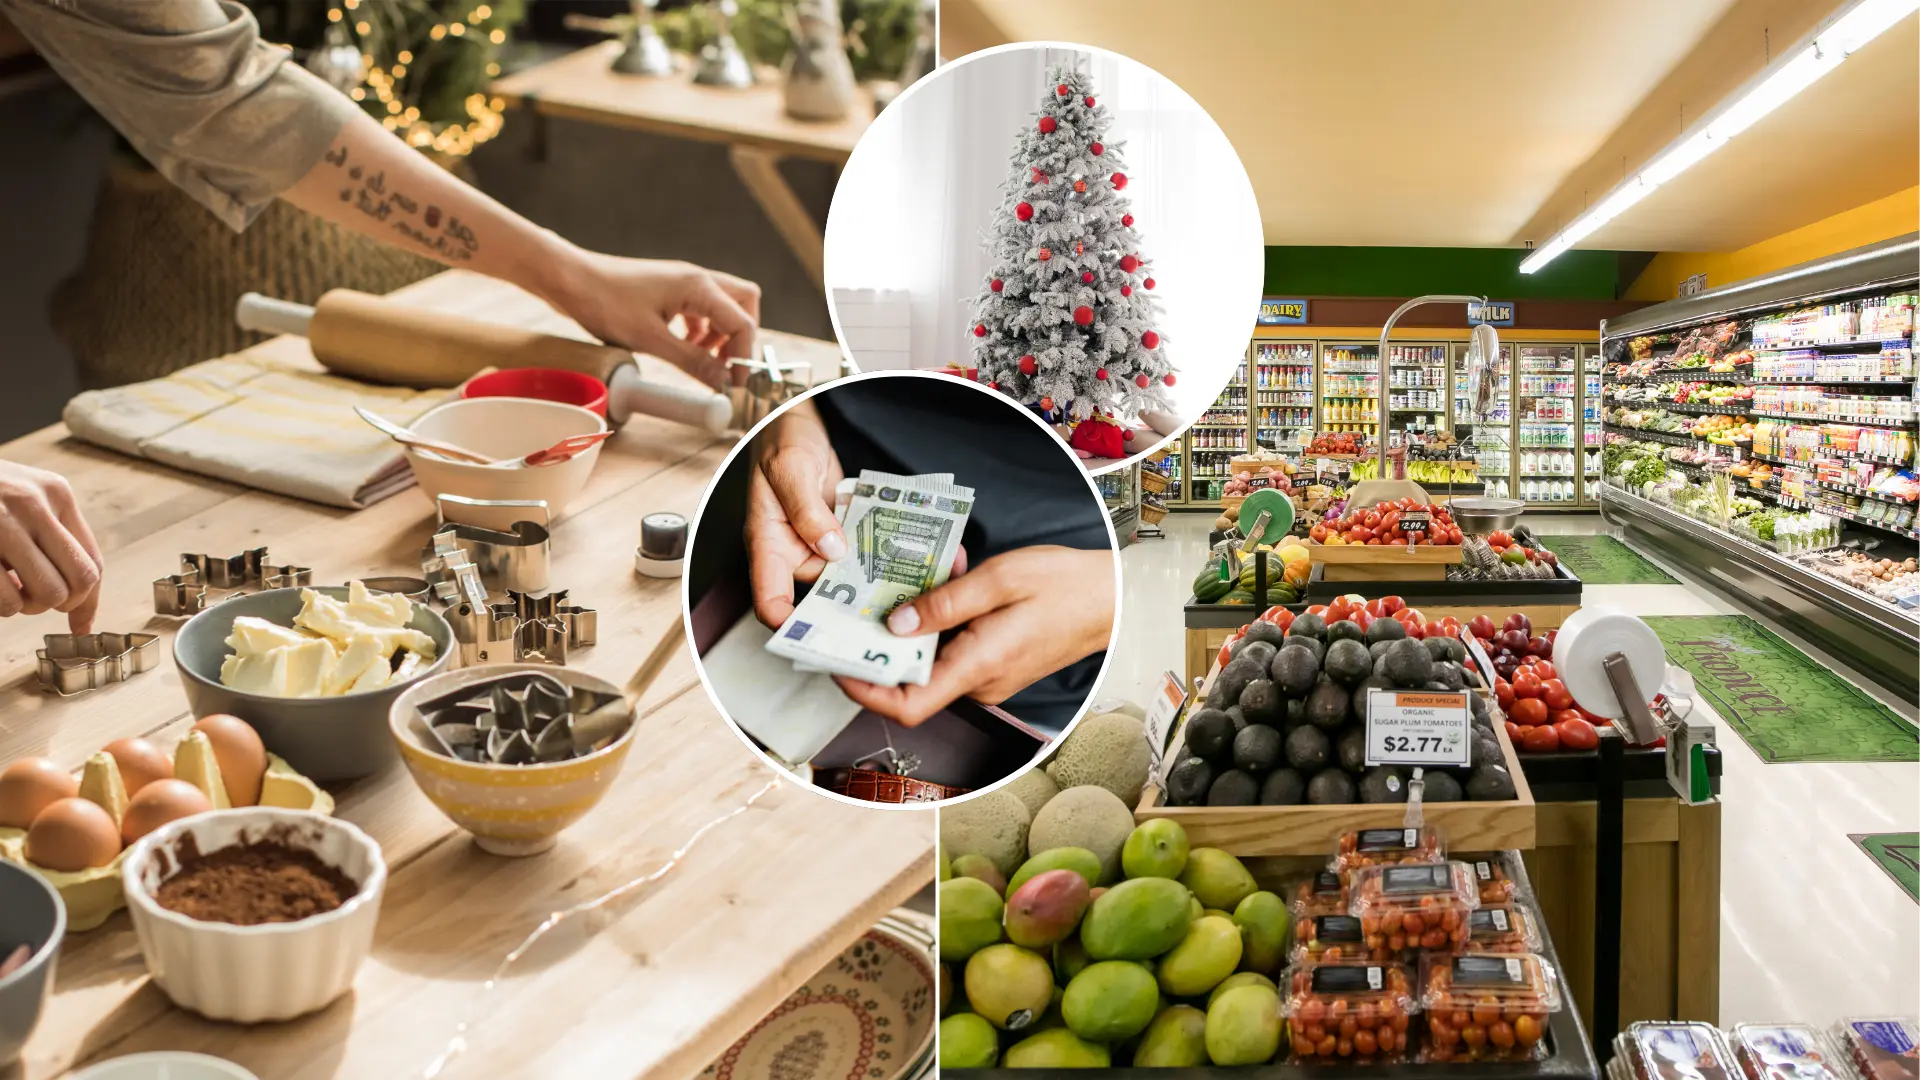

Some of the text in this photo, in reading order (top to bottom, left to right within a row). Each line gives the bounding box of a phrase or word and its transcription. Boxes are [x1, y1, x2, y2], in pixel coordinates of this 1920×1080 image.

[1261, 303, 1303, 319] DAIRY
[1470, 306, 1511, 321] MILK
[815, 578, 857, 606] 5
[863, 649, 890, 666] 5
[1676, 639, 1797, 716] PRODUCE
[1435, 697, 1461, 705] SPECIAL
[1400, 719, 1421, 727] PLUM
[1423, 719, 1463, 728] TOMATOES
[1384, 735, 1442, 753] $2.77
